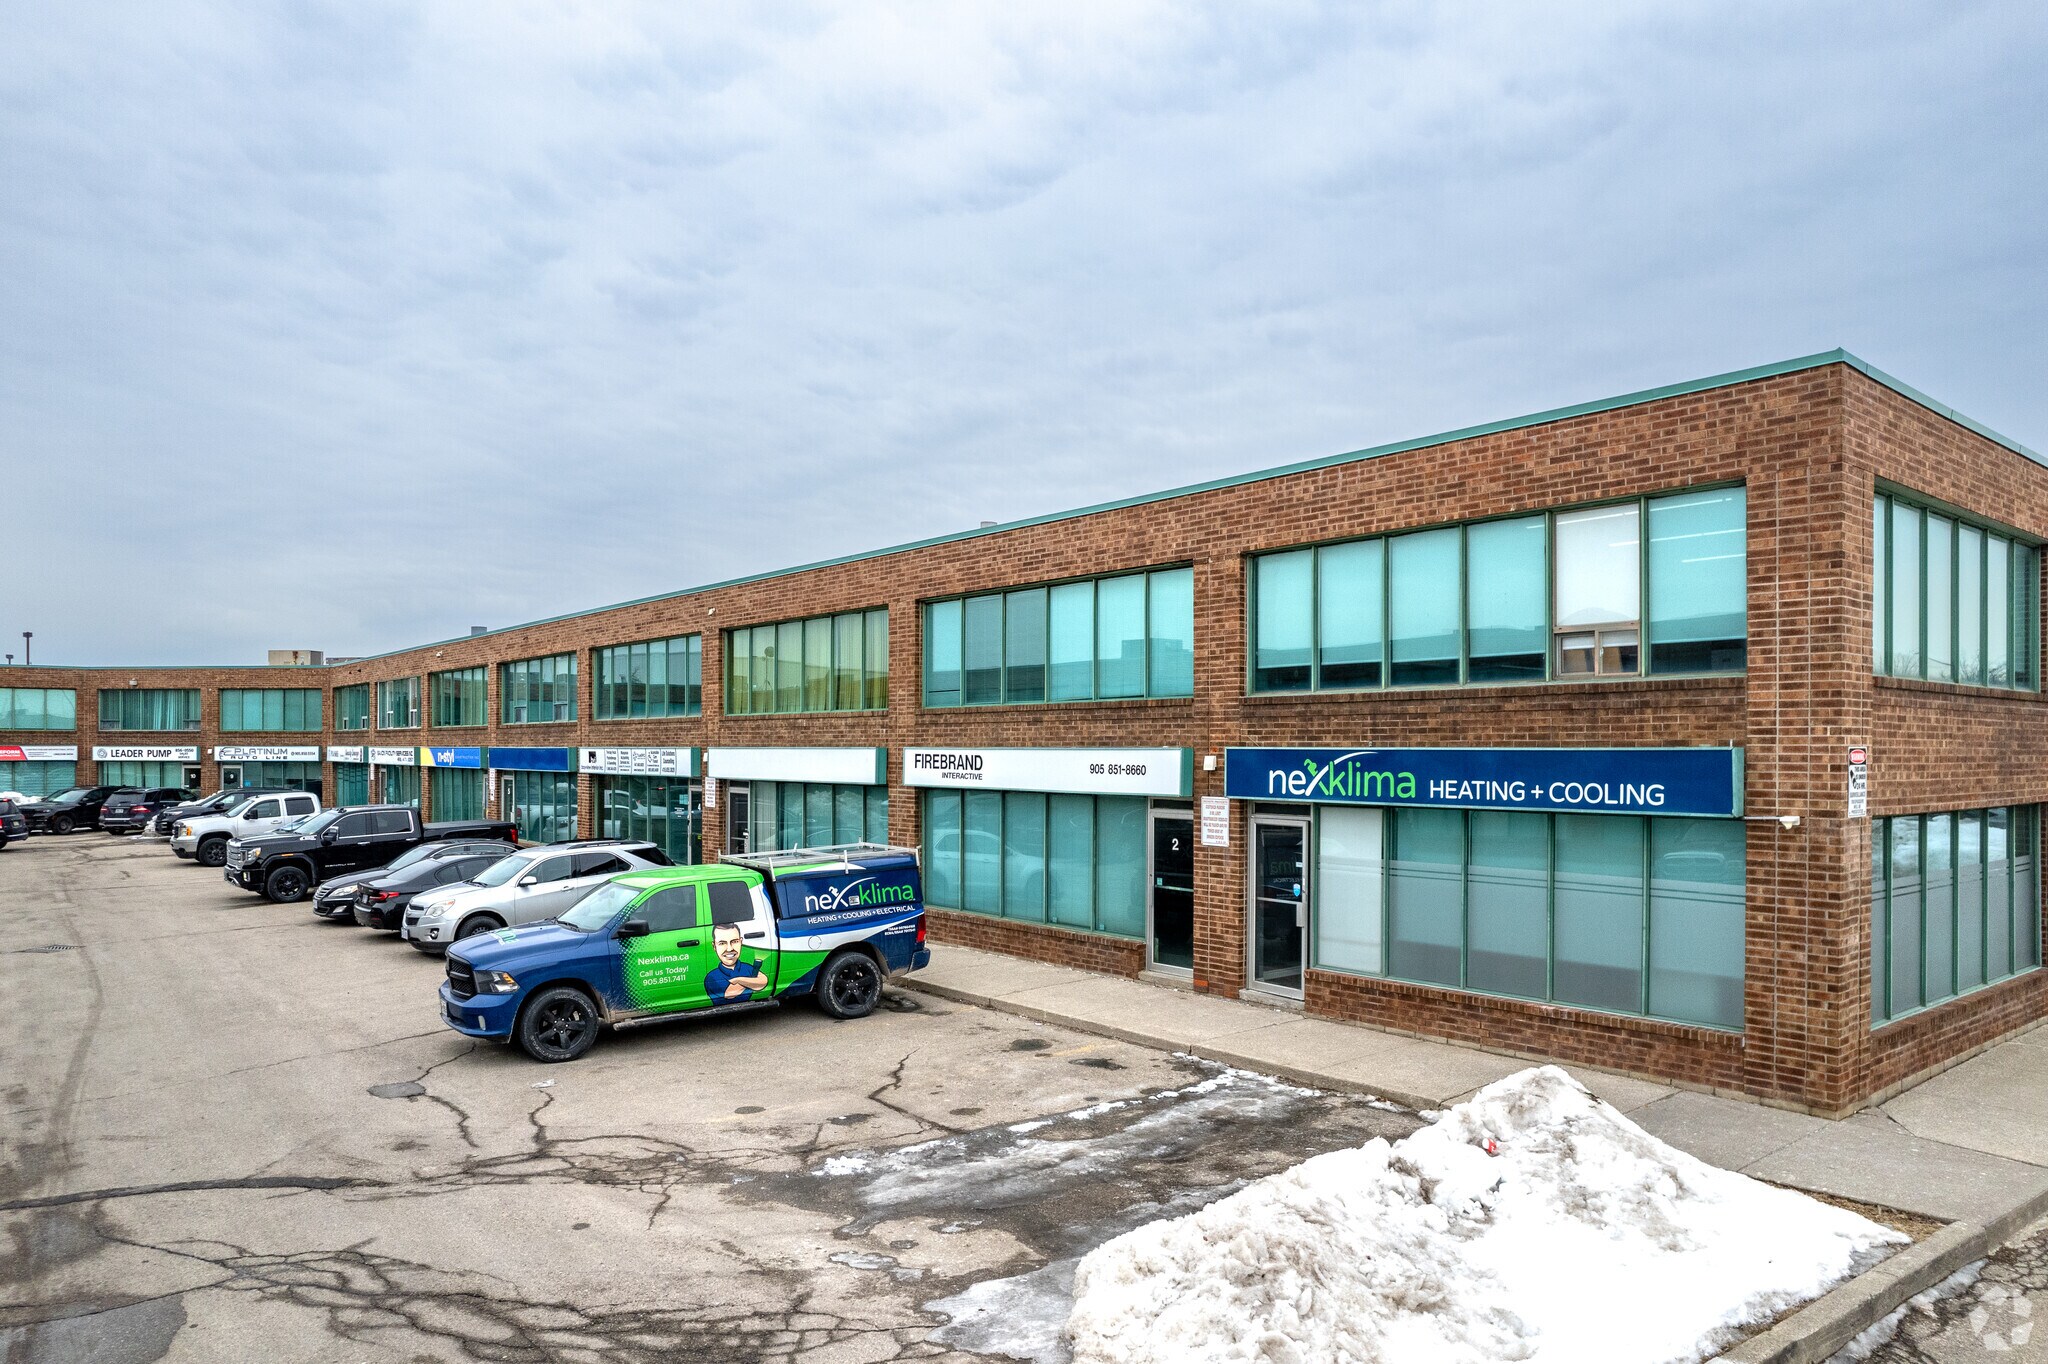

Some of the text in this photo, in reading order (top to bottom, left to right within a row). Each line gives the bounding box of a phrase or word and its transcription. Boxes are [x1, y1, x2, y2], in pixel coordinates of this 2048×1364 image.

[110, 749, 172, 758] LEADER PUMP
[914, 753, 983, 771] FIREBRAND
[1089, 763, 1147, 776] 905 851-8660
[941, 772, 983, 781] INTERACTIVE
[1429, 779, 1525, 802] HEATING
[1548, 781, 1665, 806] COOLING
[1171, 838, 1179, 851] 2
[807, 914, 838, 925] HEATING
[842, 910, 873, 920] COOLING
[876, 904, 916, 916] ELECTRICAL
[637, 953, 690, 966] Nexklima.ca
[639, 970, 653, 978] Call
[665, 965, 689, 974] Today!
[643, 974, 686, 987] 905.851.7411
